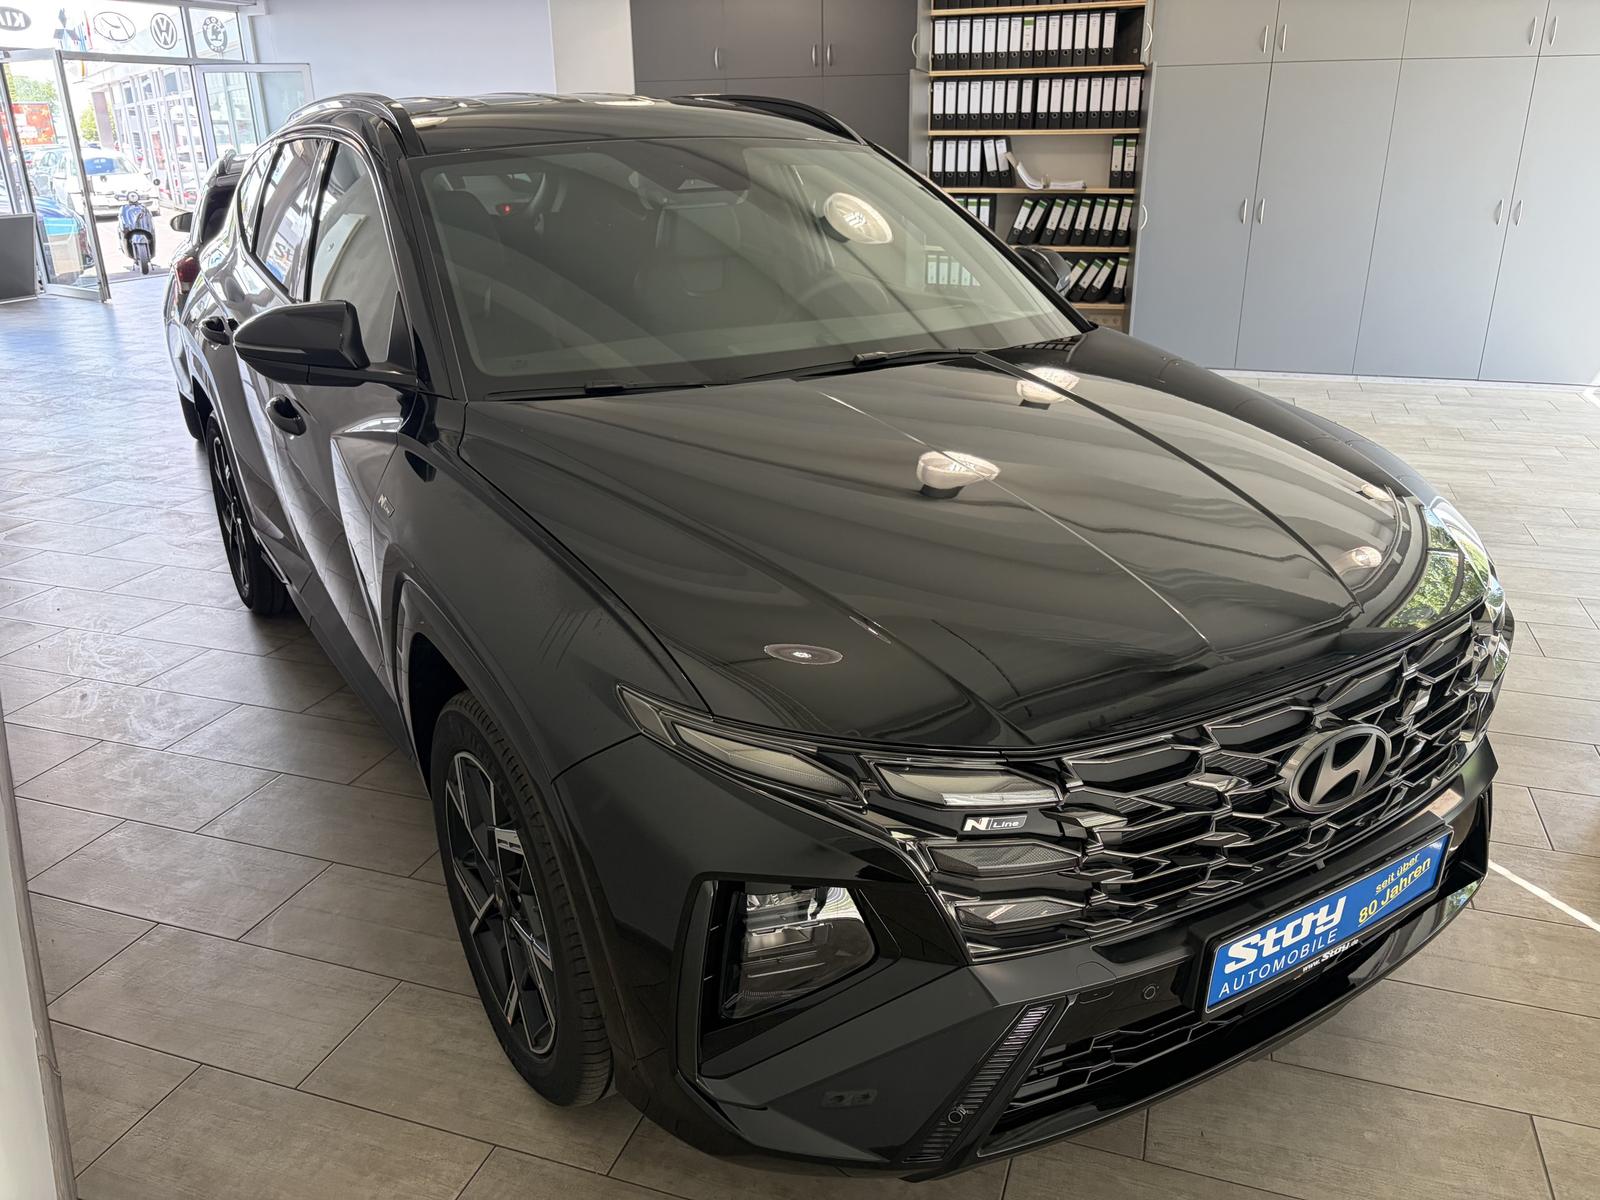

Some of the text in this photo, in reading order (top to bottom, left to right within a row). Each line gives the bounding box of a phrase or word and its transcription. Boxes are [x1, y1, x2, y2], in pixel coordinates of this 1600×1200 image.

[963, 817, 989, 831] N
[1359, 858, 1431, 923] 80 Jahren
[1375, 853, 1420, 894] seit über
[1218, 928, 1338, 998] AUTOMOBILE
